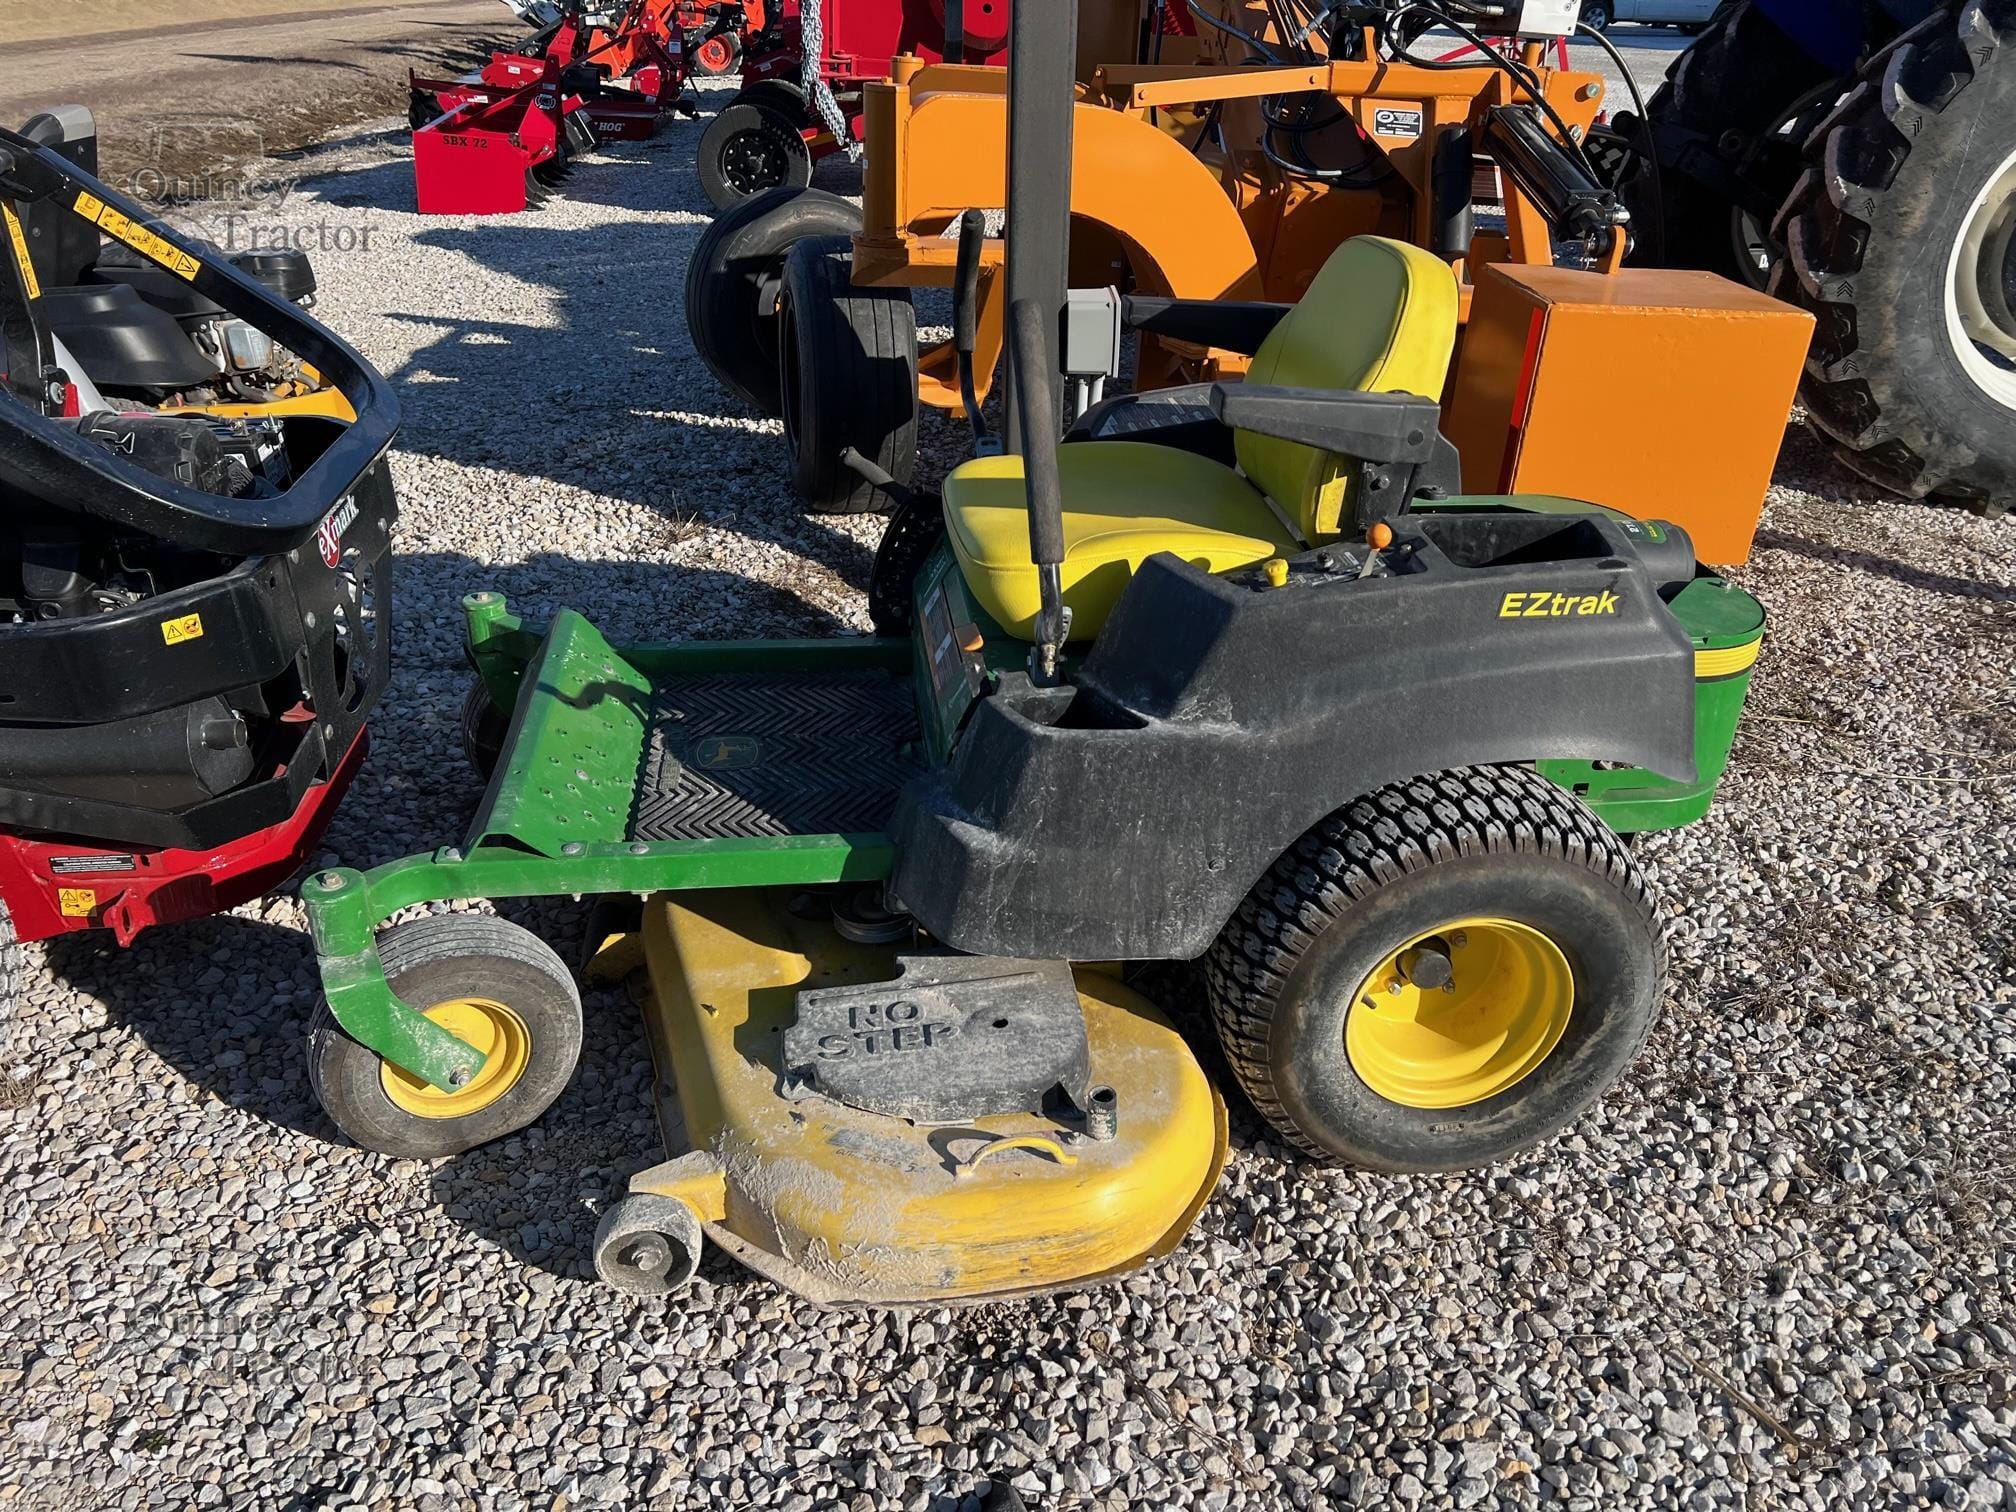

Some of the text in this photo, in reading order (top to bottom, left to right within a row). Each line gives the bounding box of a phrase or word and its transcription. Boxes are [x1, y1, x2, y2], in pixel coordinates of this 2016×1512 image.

[442, 135, 488, 149] SBX 72
[1499, 590, 1620, 617] EZtrak
[848, 1000, 924, 1030] NO
[817, 1022, 960, 1062] STEP
